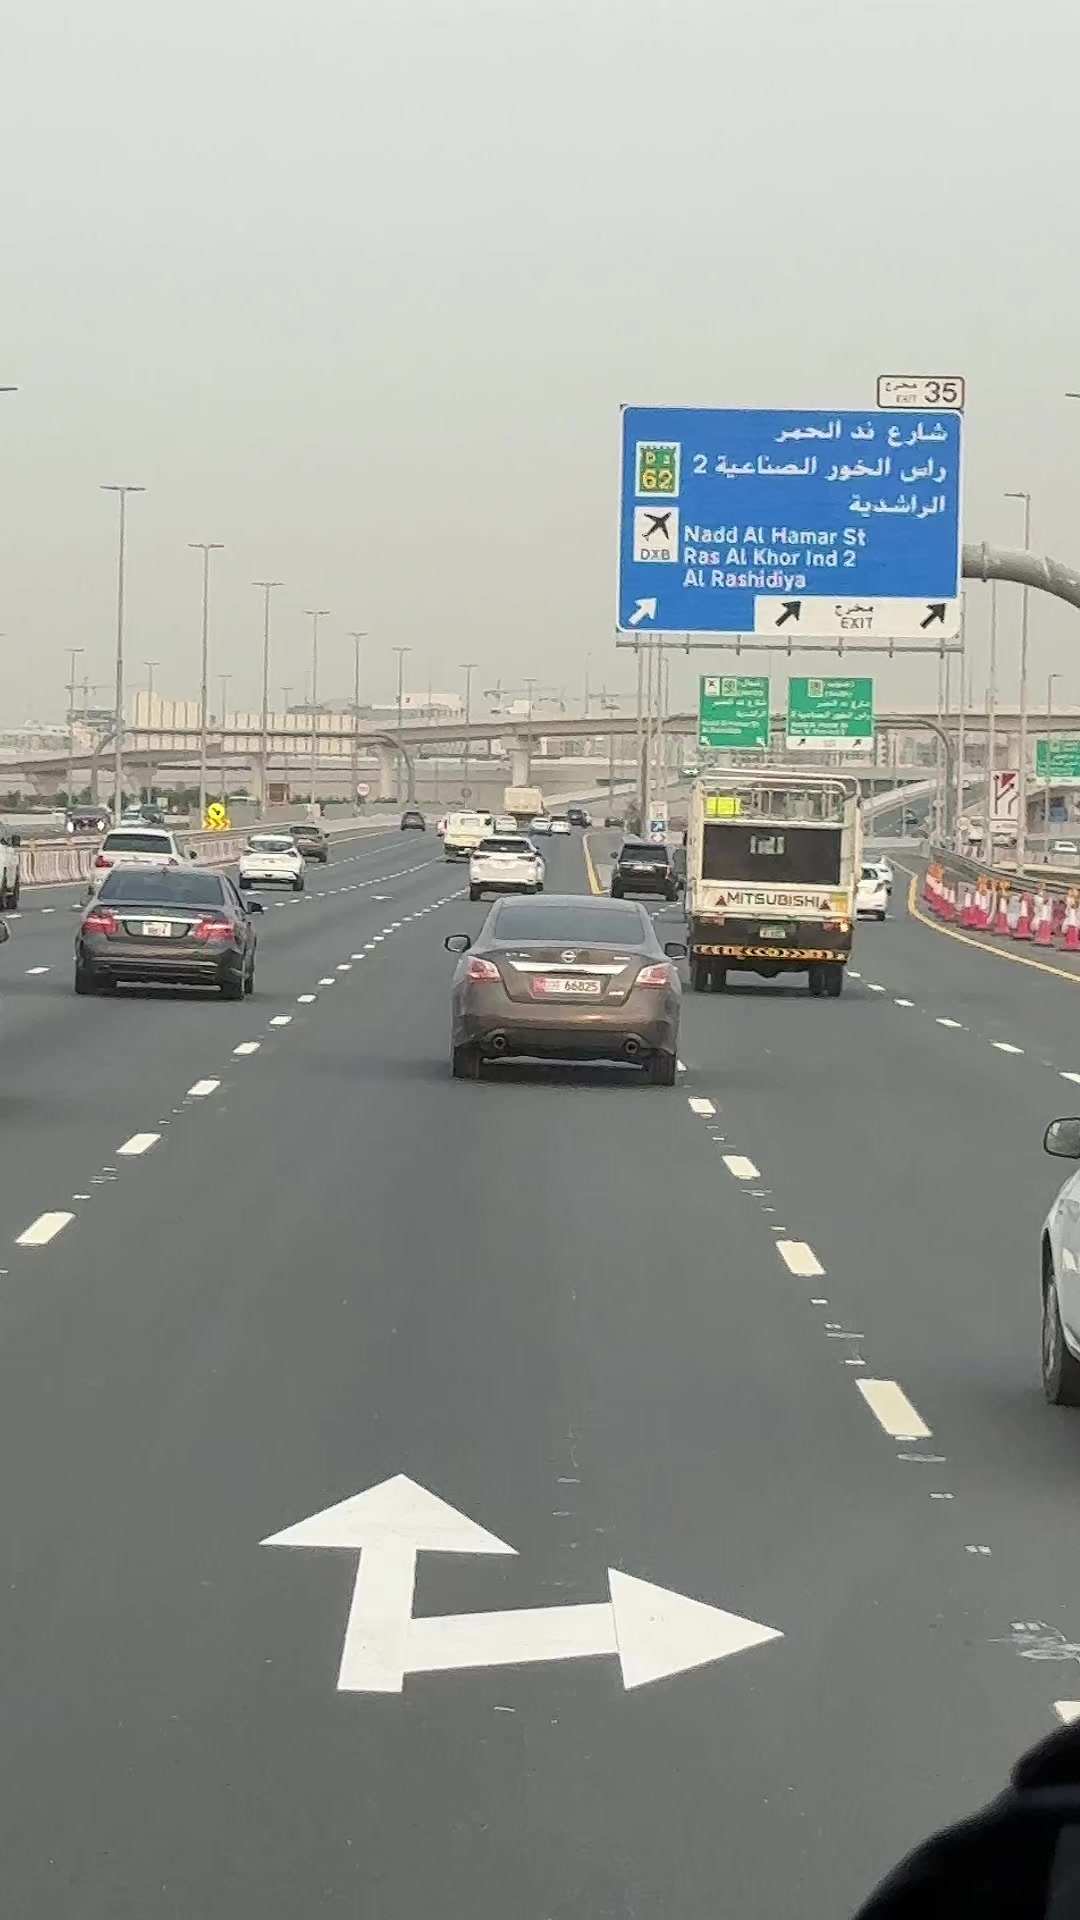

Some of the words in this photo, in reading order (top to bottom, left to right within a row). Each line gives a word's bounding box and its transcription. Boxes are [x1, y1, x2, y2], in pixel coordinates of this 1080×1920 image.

[924, 381, 957, 403] 35
[774, 418, 842, 443] الحمر
[850, 420, 875, 441] ند
[887, 420, 949, 447] شارع
[693, 453, 708, 475] 2
[715, 453, 818, 478] الصناعية
[824, 453, 891, 482] الخور
[642, 469, 672, 489] 62
[848, 494, 946, 518] الراشدية
[684, 525, 738, 545] Nadd
[743, 526, 765, 545] Al
[771, 527, 836, 546] Hamar
[843, 527, 866, 546] St
[640, 548, 671, 561] DXB
[684, 547, 720, 566] Ras
[726, 548, 747, 566] Al
[753, 549, 800, 567] Khor
[806, 549, 839, 568] Ind
[843, 550, 857, 568] 2
[683, 569, 705, 588] Al
[711, 569, 807, 592] Rashidiya
[840, 617, 873, 629] EXIT
[727, 891, 820, 908] MITSUBISHI
